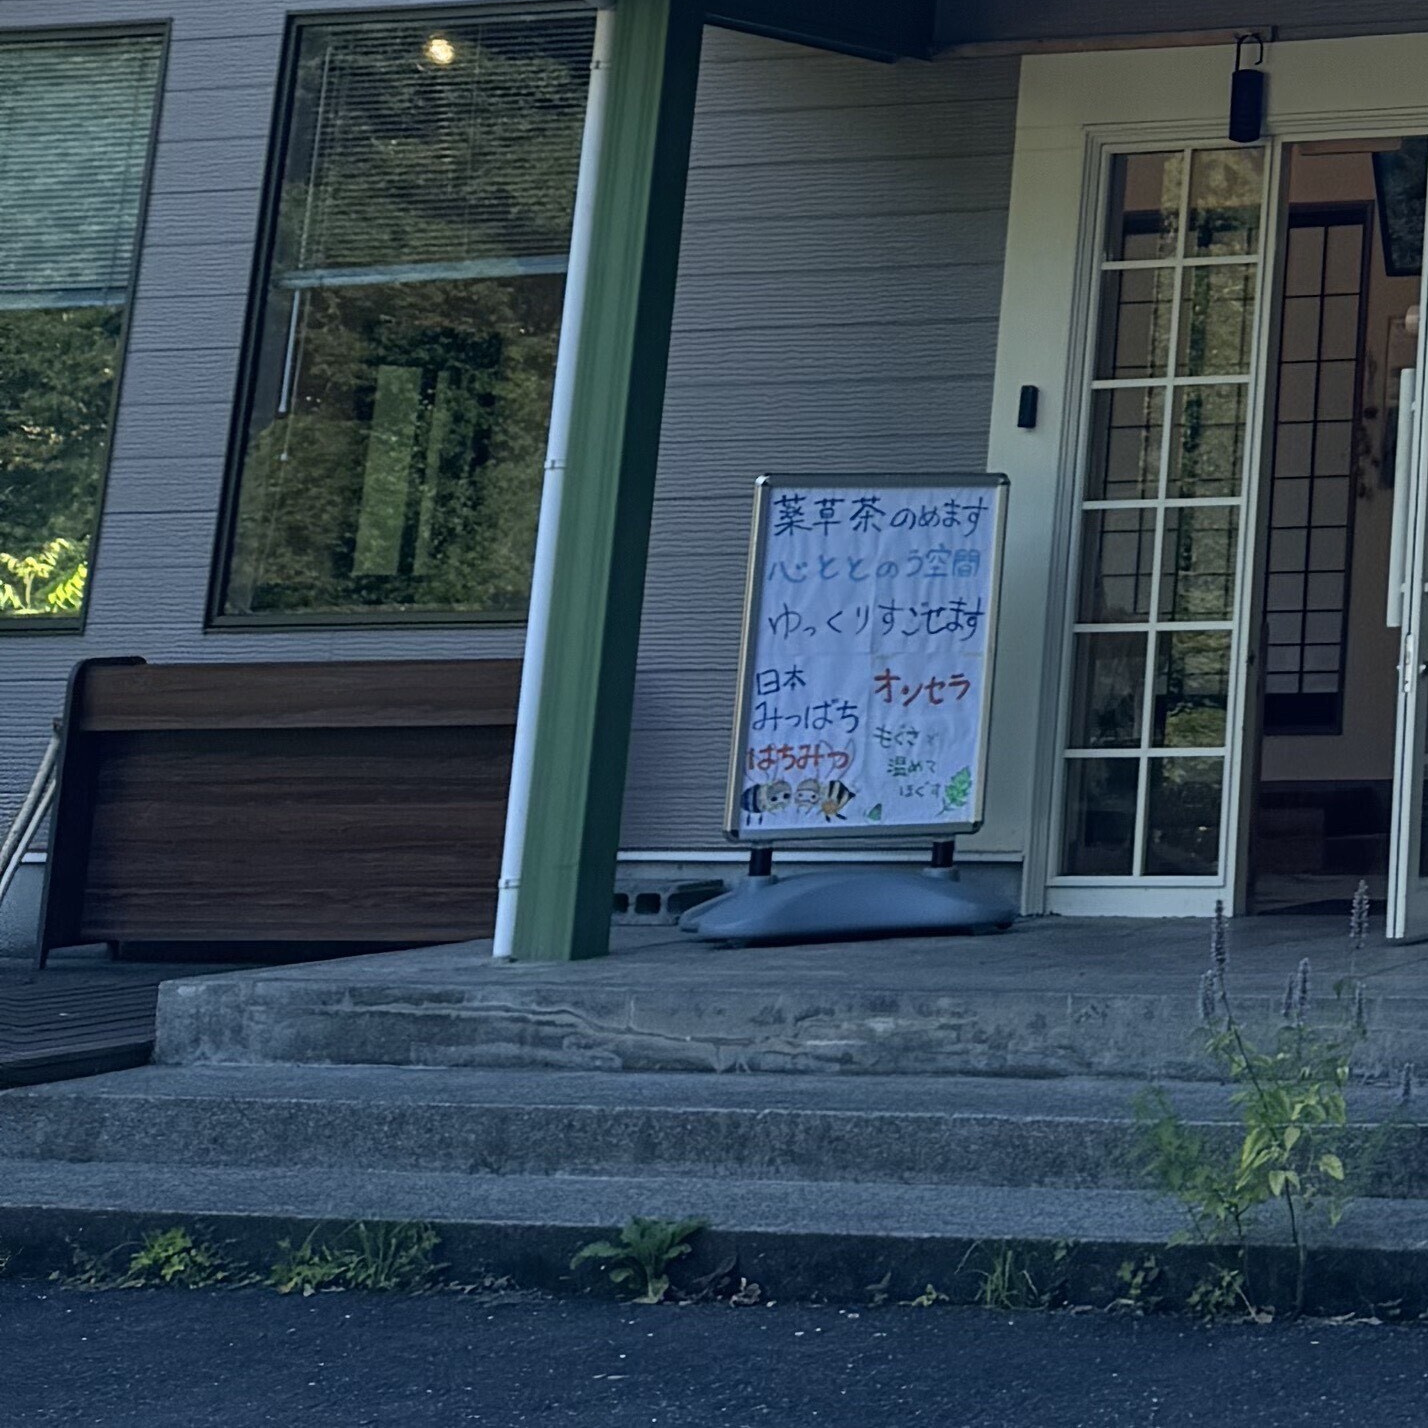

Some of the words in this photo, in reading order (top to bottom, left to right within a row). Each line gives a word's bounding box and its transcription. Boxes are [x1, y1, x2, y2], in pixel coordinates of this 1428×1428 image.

[773, 494, 989, 538] 薬草茶のめます
[767, 544, 981, 583] 心ととのう空間
[768, 596, 985, 642] ゆっくりすごせます
[756, 664, 806, 695] 日本
[874, 668, 971, 707] オンセラ
[752, 698, 859, 734] みつばち
